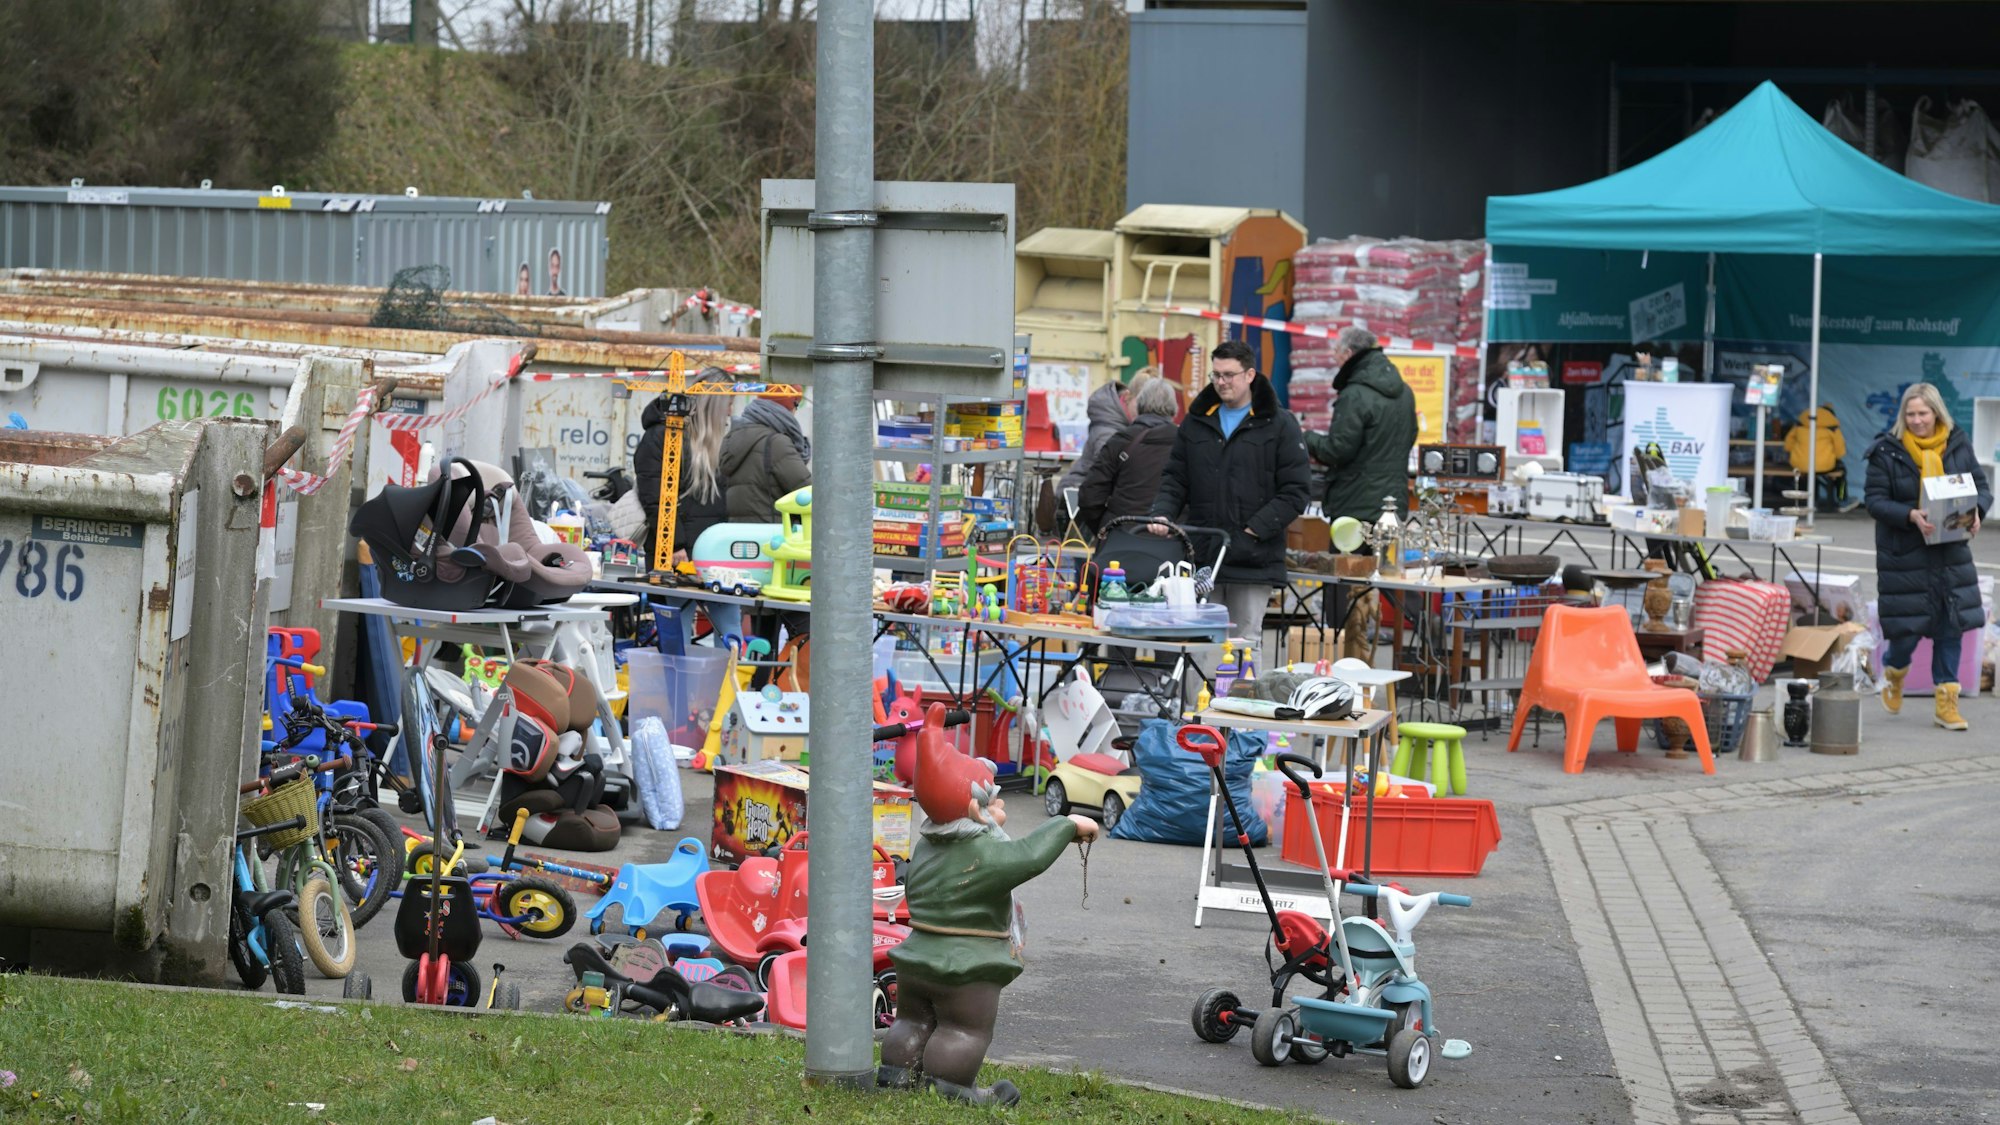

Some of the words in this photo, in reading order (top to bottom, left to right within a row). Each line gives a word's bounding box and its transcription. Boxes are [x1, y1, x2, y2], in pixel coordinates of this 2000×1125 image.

[1558, 311, 1626, 329] Abfallberatung
[1819, 314, 1875, 334] Reststoff
[1876, 319, 1903, 331] zum
[1906, 317, 1961, 336] Rohstoff
[157, 386, 254, 421] 6026
[560, 419, 609, 446] relo
[1671, 441, 1705, 455] BAV
[41, 517, 133, 538] BERINGER
[62, 531, 110, 544] Behälter
[273, 762, 297, 774] PUKY
[746, 817, 769, 843] HERO
[1240, 896, 1294, 909] LEHRTZ
